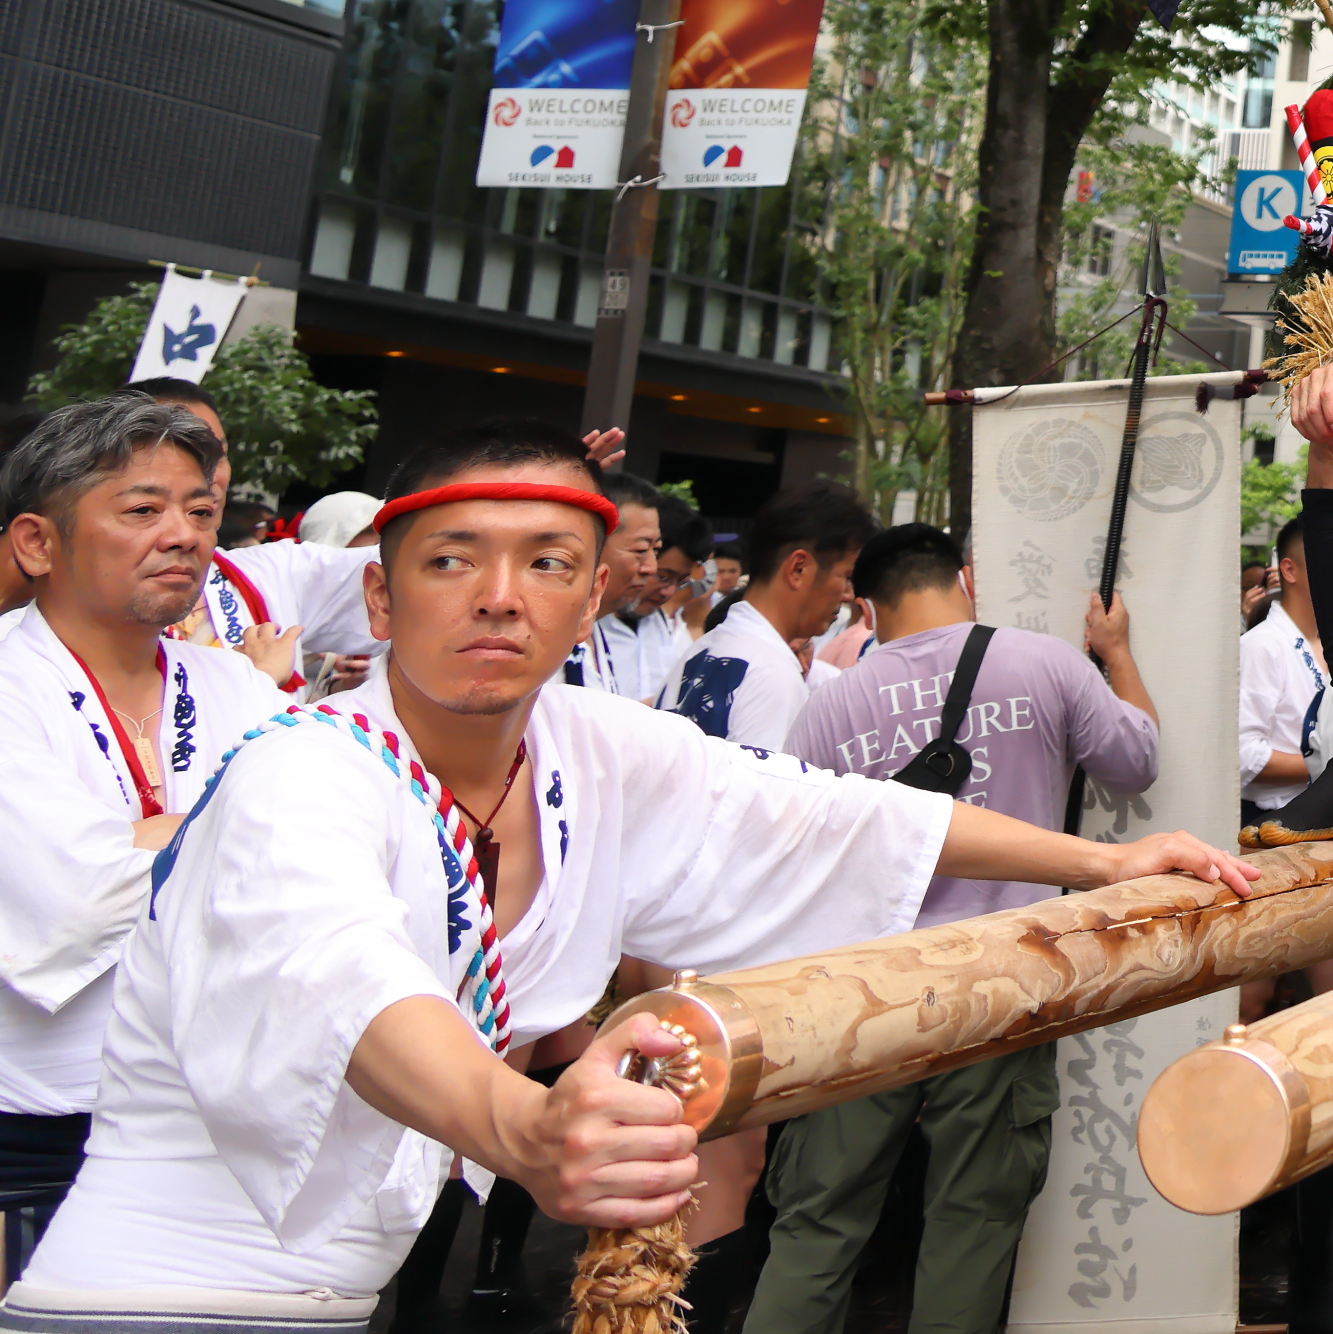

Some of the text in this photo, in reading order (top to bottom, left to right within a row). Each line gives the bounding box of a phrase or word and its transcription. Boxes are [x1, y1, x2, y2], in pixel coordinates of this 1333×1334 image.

[528, 98, 628, 114] WELCOME
[701, 98, 796, 114] WELCOME
[507, 172, 593, 184] SEKISUI HOUSE
[723, 172, 758, 182] HOUSE
[878, 670, 956, 716] TH
